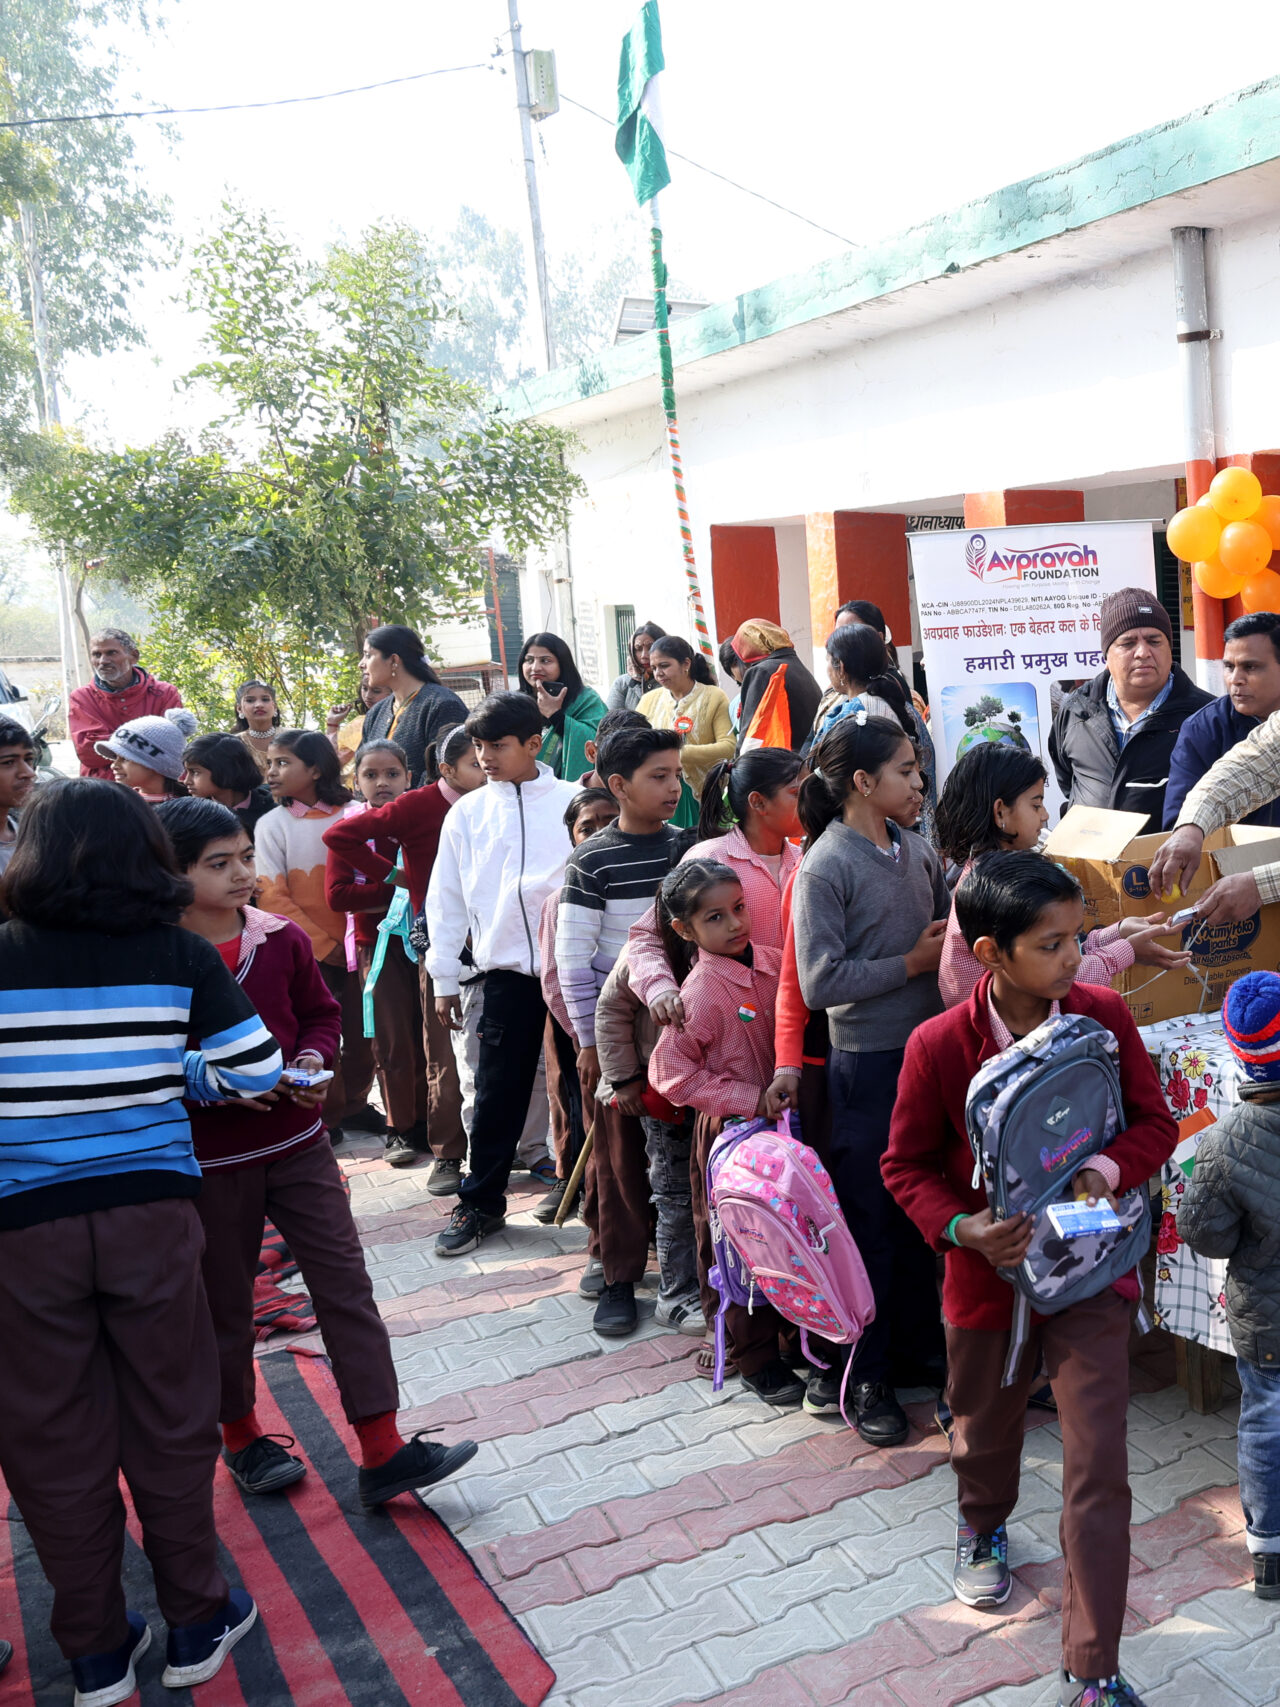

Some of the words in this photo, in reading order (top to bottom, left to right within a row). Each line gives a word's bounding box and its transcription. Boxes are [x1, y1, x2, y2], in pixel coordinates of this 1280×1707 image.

[986, 545, 1099, 576] Avpravah
[1023, 567, 1099, 582] FOUNDATION
[922, 626, 960, 641] अवप्रवाह
[1009, 622, 1026, 637] एक
[1028, 616, 1056, 636] बेहतर
[1058, 619, 1077, 633] कल
[1079, 614, 1090, 632] के
[963, 648, 1015, 674] हमारी
[1020, 651, 1069, 675] प्रमुख
[1132, 871, 1144, 886] L
[1209, 935, 1239, 953] pants
